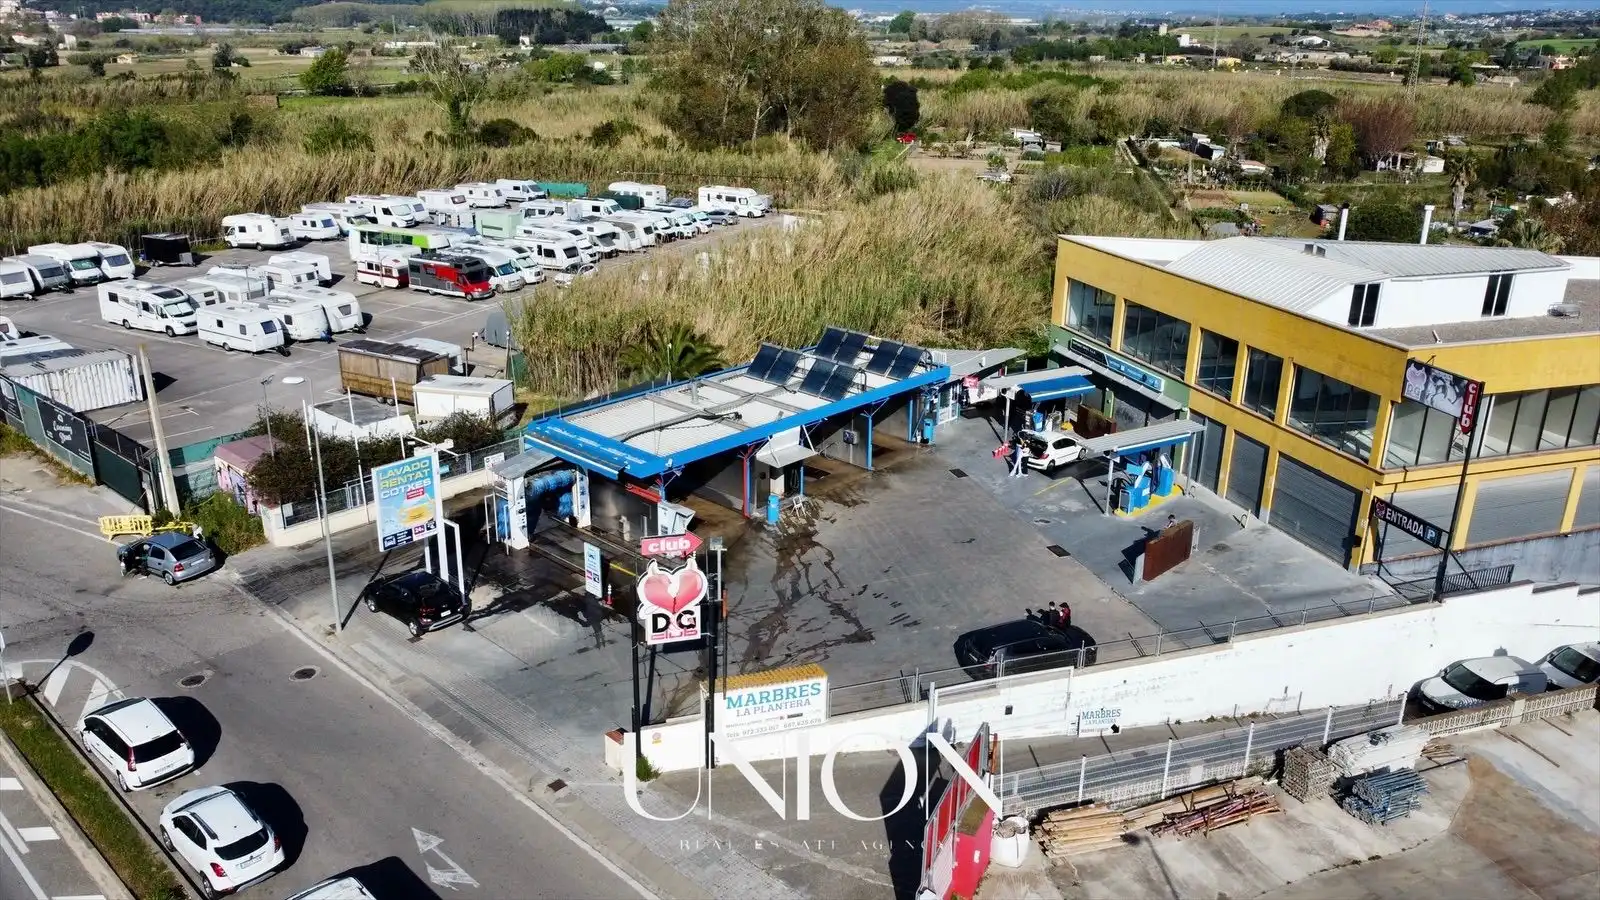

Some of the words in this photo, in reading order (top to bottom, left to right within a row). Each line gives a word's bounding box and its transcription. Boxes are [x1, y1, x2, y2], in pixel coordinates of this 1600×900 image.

[1461, 383, 1477, 427] club
[380, 460, 430, 479] LAVADO
[380, 469, 431, 489] RENTAT
[381, 478, 432, 499] COTXES
[1385, 507, 1424, 537] ENTRADA
[648, 538, 691, 552] club
[726, 682, 821, 709] MARBRES
[736, 708, 751, 717] LA
[753, 698, 811, 714] PLANTERA
[1081, 709, 1121, 720] MARBRES
